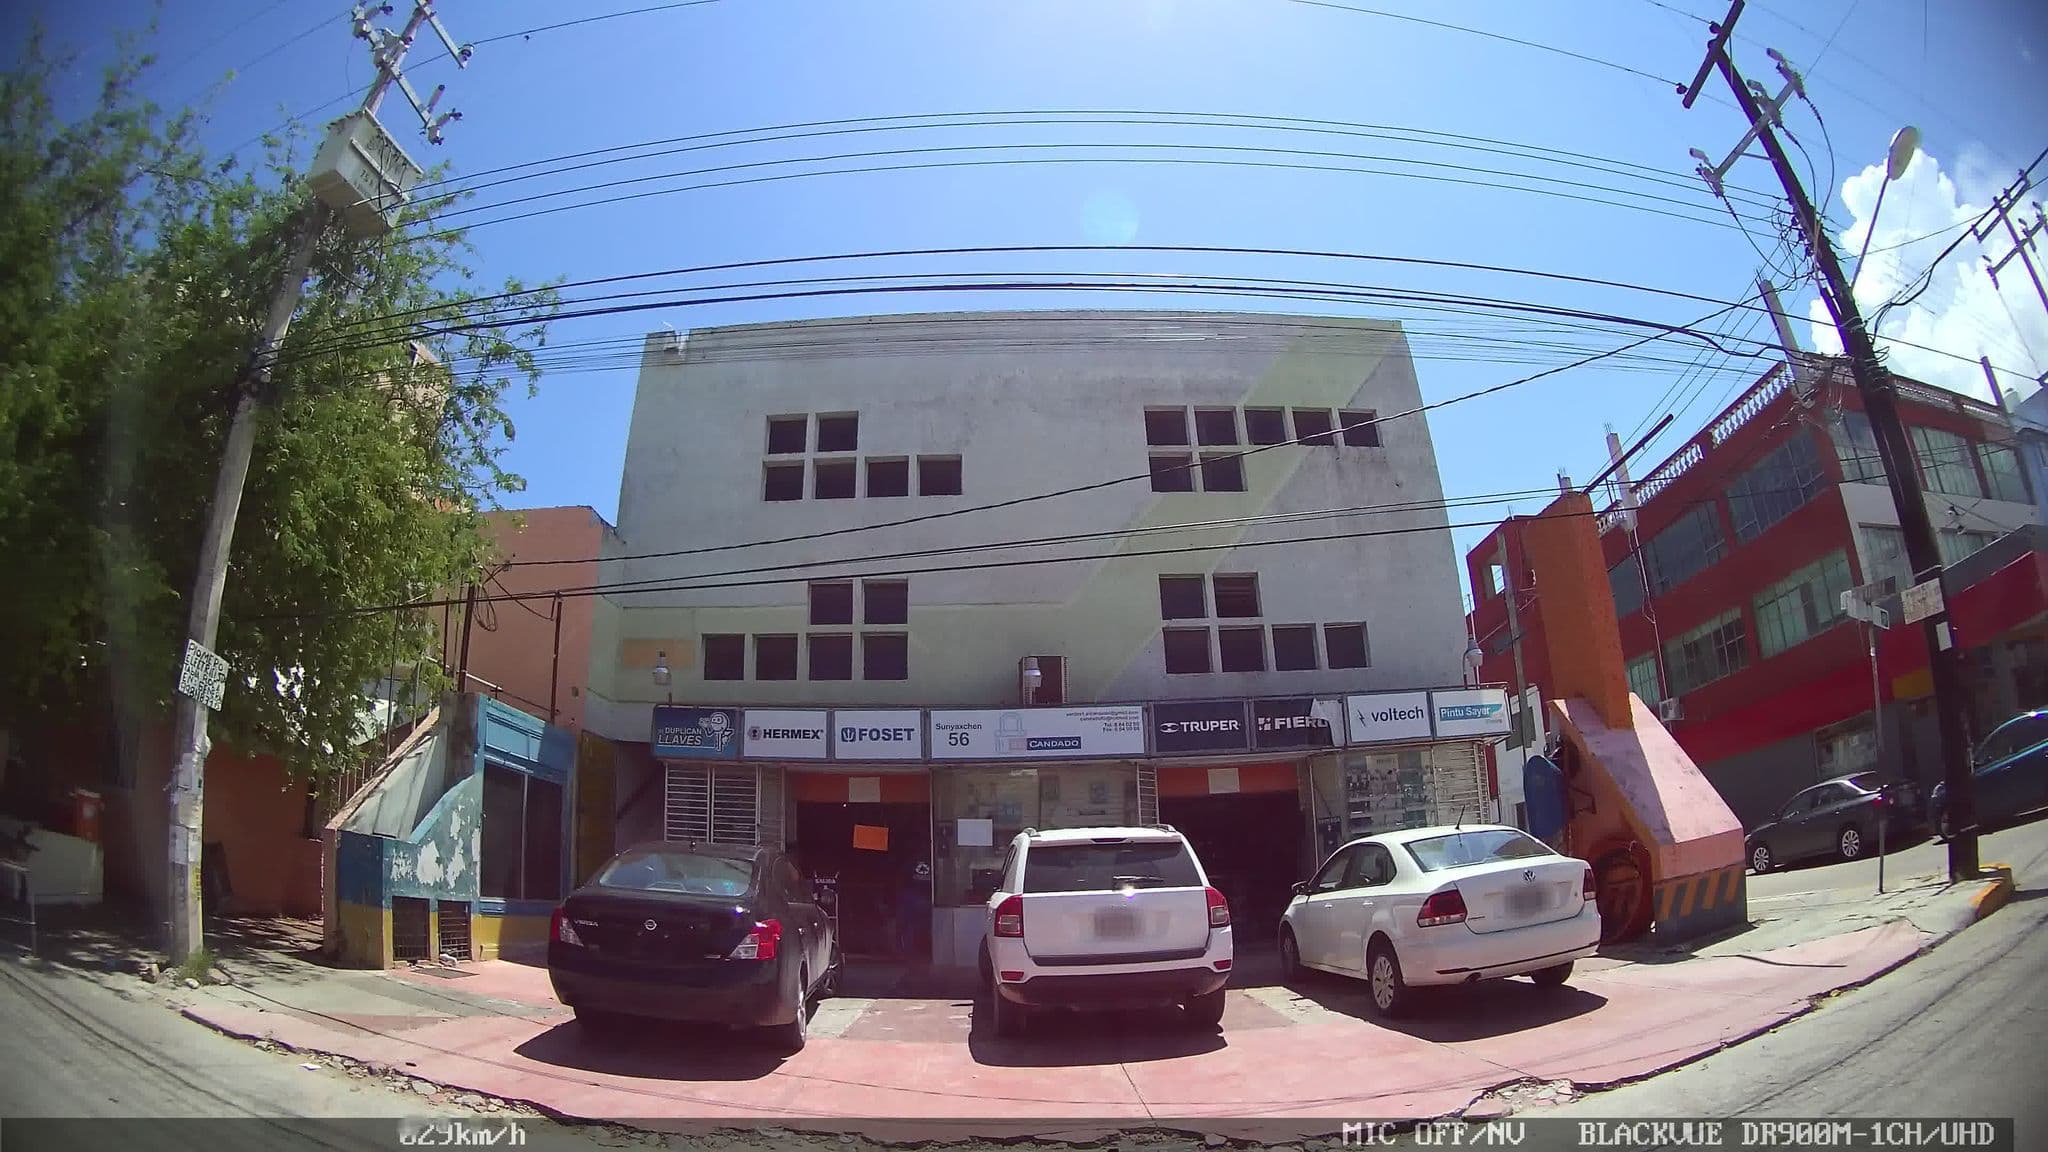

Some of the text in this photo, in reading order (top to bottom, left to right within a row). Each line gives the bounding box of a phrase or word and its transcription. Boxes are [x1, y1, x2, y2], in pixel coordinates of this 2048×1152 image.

[1371, 706, 1424, 723] voltech
[1440, 708, 1464, 718] Pintu
[665, 727, 702, 735] DUPLICAN
[935, 722, 982, 731] Sunyaxchen
[1180, 719, 1239, 733] TRUPER
[763, 728, 821, 740] HERMEX
[858, 728, 915, 742] FOSET
[948, 732, 970, 747] 56
[658, 735, 702, 746] LLAVES
[1029, 739, 1080, 749] CANDADO
